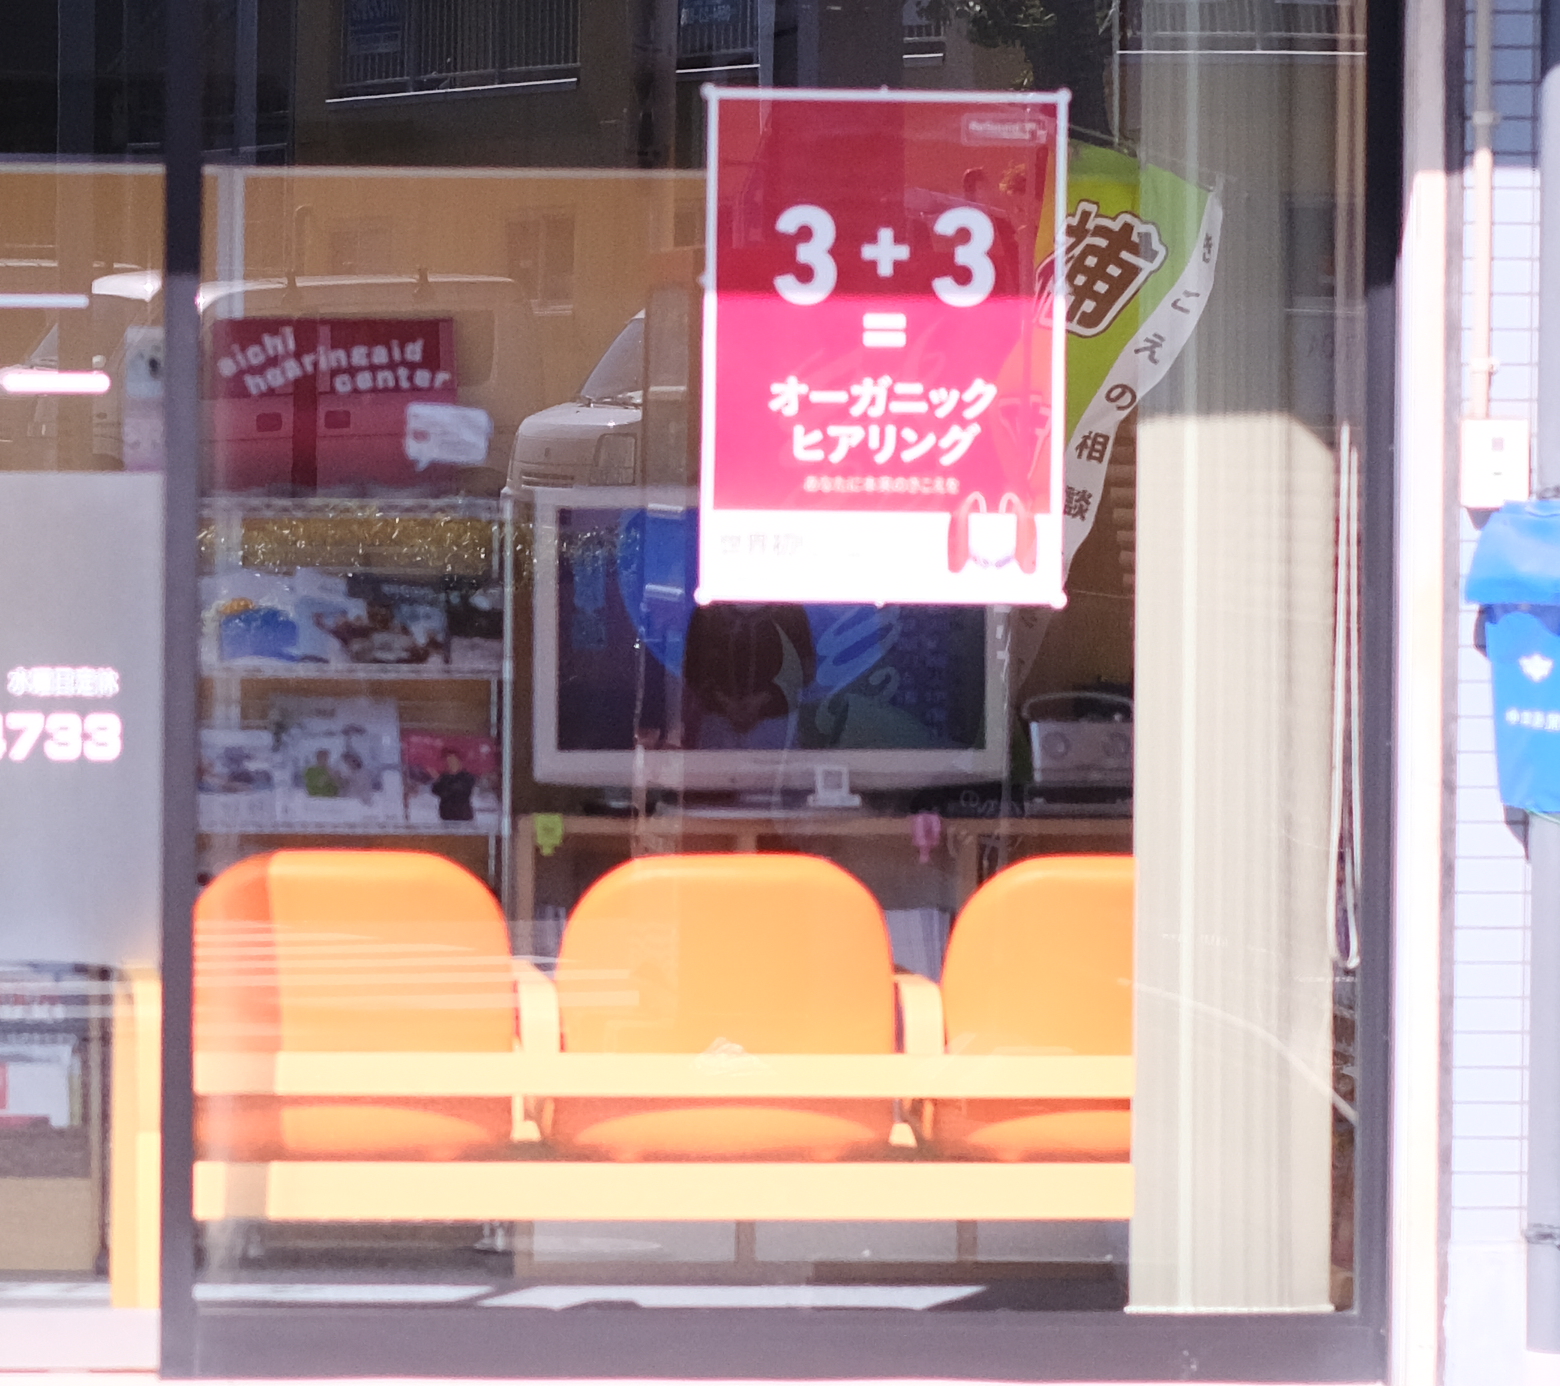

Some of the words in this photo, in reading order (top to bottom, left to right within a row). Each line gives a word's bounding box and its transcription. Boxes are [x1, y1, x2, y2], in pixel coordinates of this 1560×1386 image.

[332, 365, 452, 394] center
[768, 375, 998, 419] オーガニック
[792, 423, 982, 466] ヒアリング
